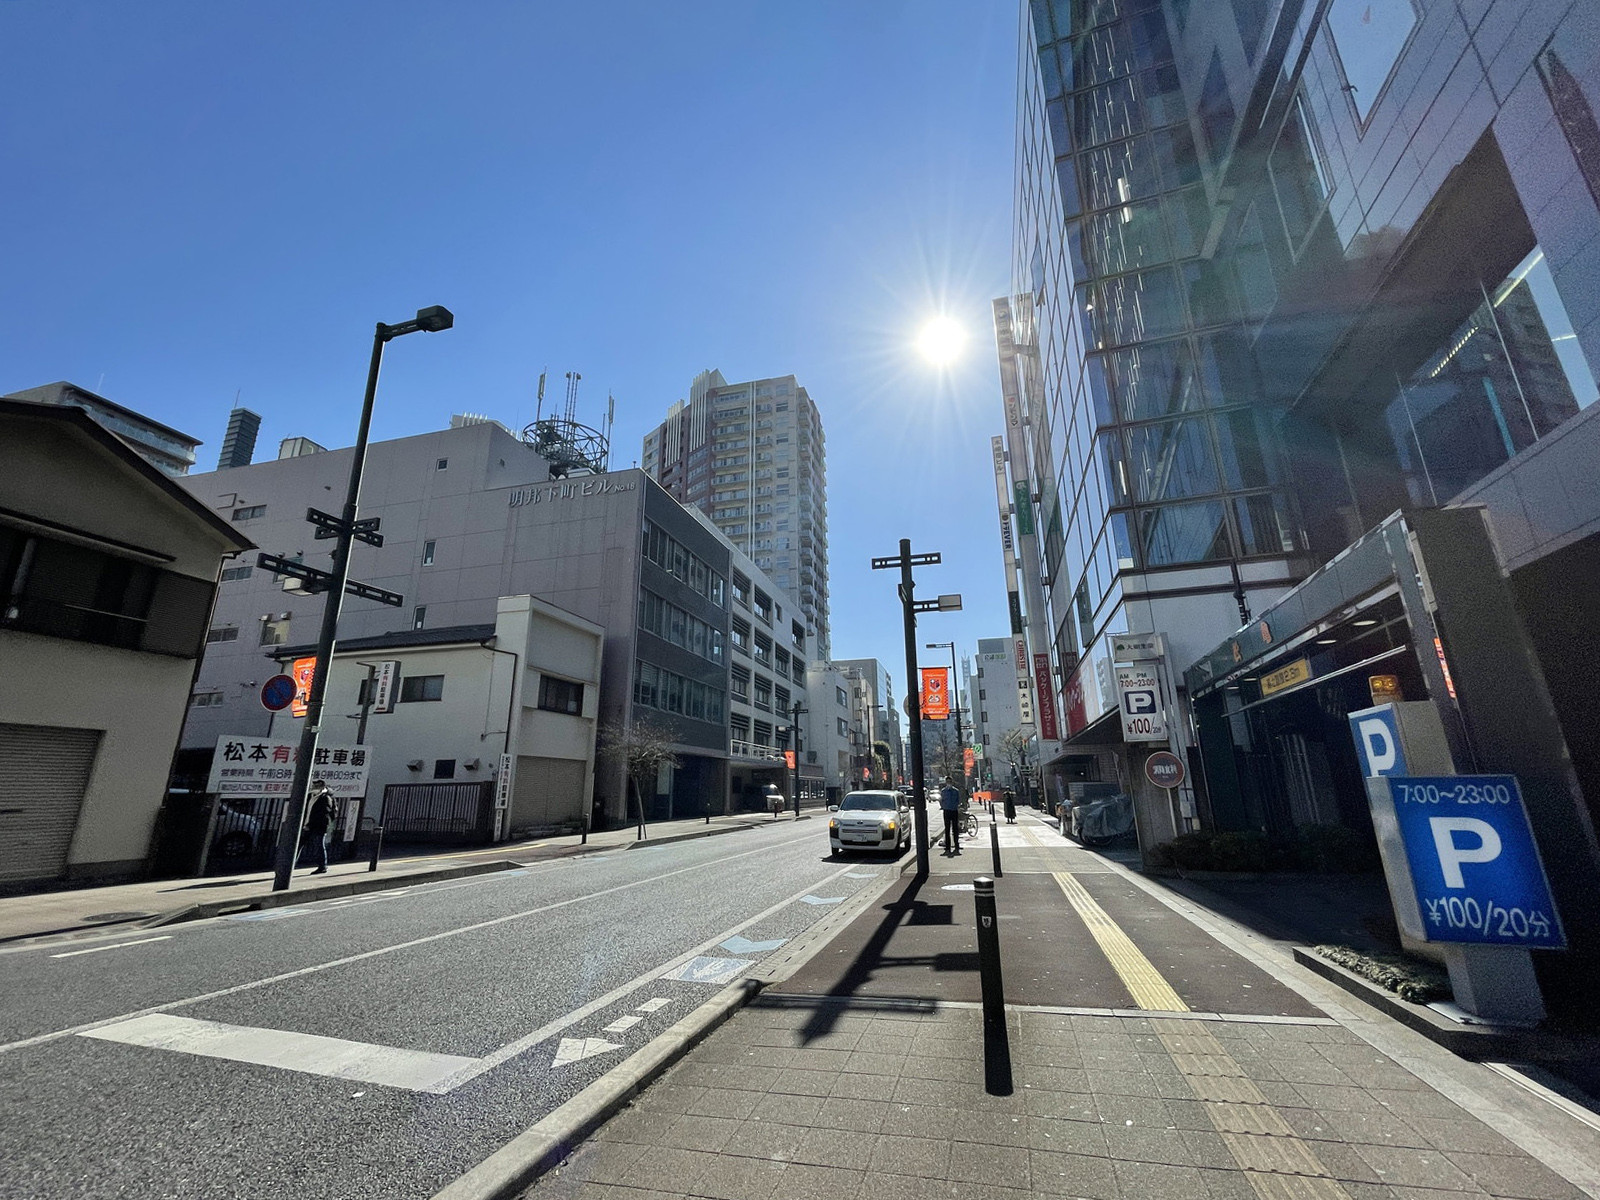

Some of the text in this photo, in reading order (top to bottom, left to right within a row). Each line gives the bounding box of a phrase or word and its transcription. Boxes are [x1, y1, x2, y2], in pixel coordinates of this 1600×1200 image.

[509, 479, 613, 507] 明邦下町ビル
[1128, 692, 1152, 713] P
[1358, 718, 1396, 777] P
[1429, 817, 1502, 888] P
[1424, 896, 1550, 937] ¥100/20分
